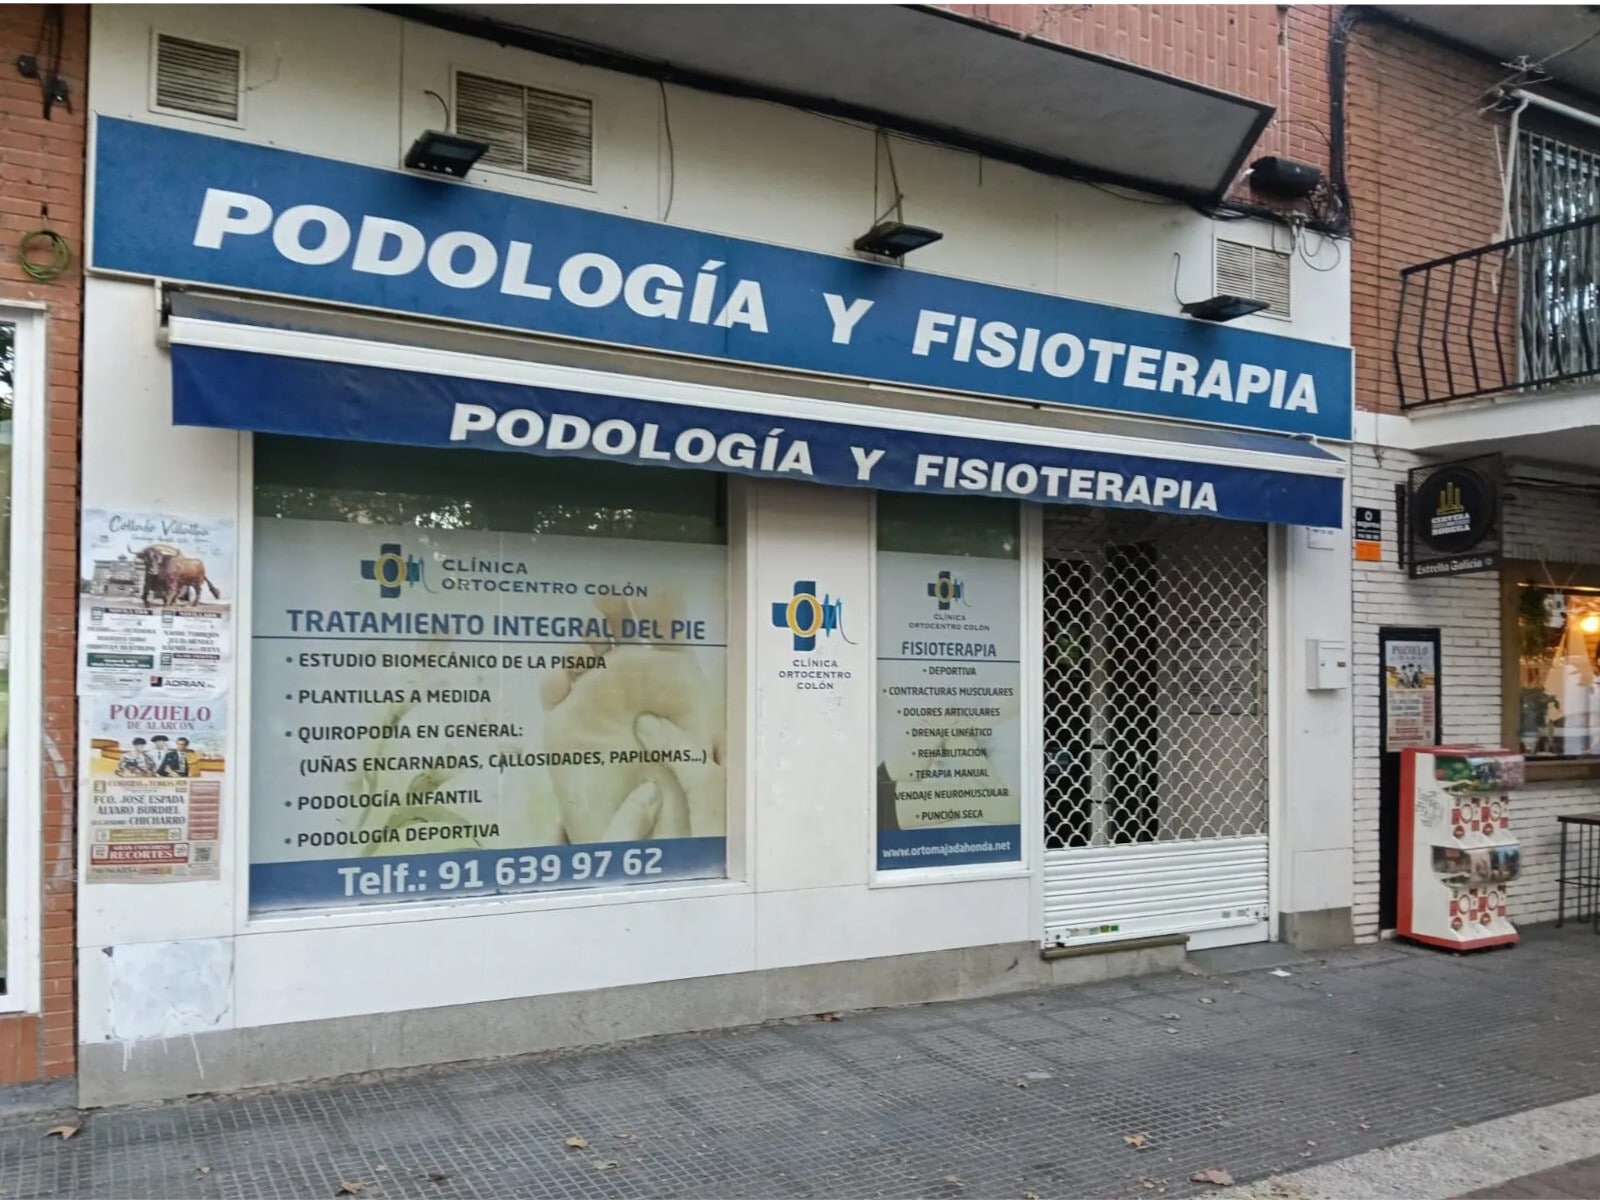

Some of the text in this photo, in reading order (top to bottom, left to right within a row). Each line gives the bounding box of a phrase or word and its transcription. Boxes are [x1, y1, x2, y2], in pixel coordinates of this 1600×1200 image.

[192, 187, 1319, 415] PODOLOGÍA Y FISIOTERAPIA
[449, 402, 1218, 512] PODOLOGÍA Y FISIOTERAPIA
[441, 556, 528, 575] CLÍNICA
[441, 577, 648, 598] ORTOCENTRO COLÓN
[933, 613, 967, 621] CLÍNICA
[286, 609, 706, 641] TRATAMIENTO INTEGRAL DEL PIE
[908, 622, 961, 630] ORTOCENTRO
[901, 641, 997, 657] FISIOTERAPIA
[299, 651, 607, 669] ESTUDIO BIOMECÁNICO DE LA PISADA
[792, 657, 838, 668] CLÍNICA
[778, 670, 851, 679] ORTOCENTRO
[929, 666, 977, 676] DEPORTIVA
[796, 680, 834, 690] COLÓN
[889, 687, 1014, 697] CONTRACTURAS MUSCULARES
[299, 689, 491, 704] PLANTILLAS A MEDIDA
[110, 704, 212, 721] POZUELO
[903, 707, 1001, 717] DOLORES ARTICULARES
[417, 725, 439, 739] EN
[444, 724, 523, 738] GENERAL:
[911, 726, 992, 738] DRENAJE LINFÁTICO
[300, 749, 707, 776] (UÑAS ENCARNADAS, CALLOSIDADES, PAPILOMAS...)
[915, 768, 989, 779] TERAPIA MANUAL
[298, 790, 483, 810] PODOLOGÍA INFANTIL
[894, 788, 1009, 801] VENDAJE NEUROMUSCULAR
[921, 808, 983, 820] PUNCIÓN SECA
[298, 823, 500, 847] PODOLOGÍA DEPORTIVA
[109, 850, 174, 859] RECORTES
[882, 841, 1011, 858] www.ortomajadahonda.net
[337, 847, 663, 897] Telf.: 91 639 97 62
